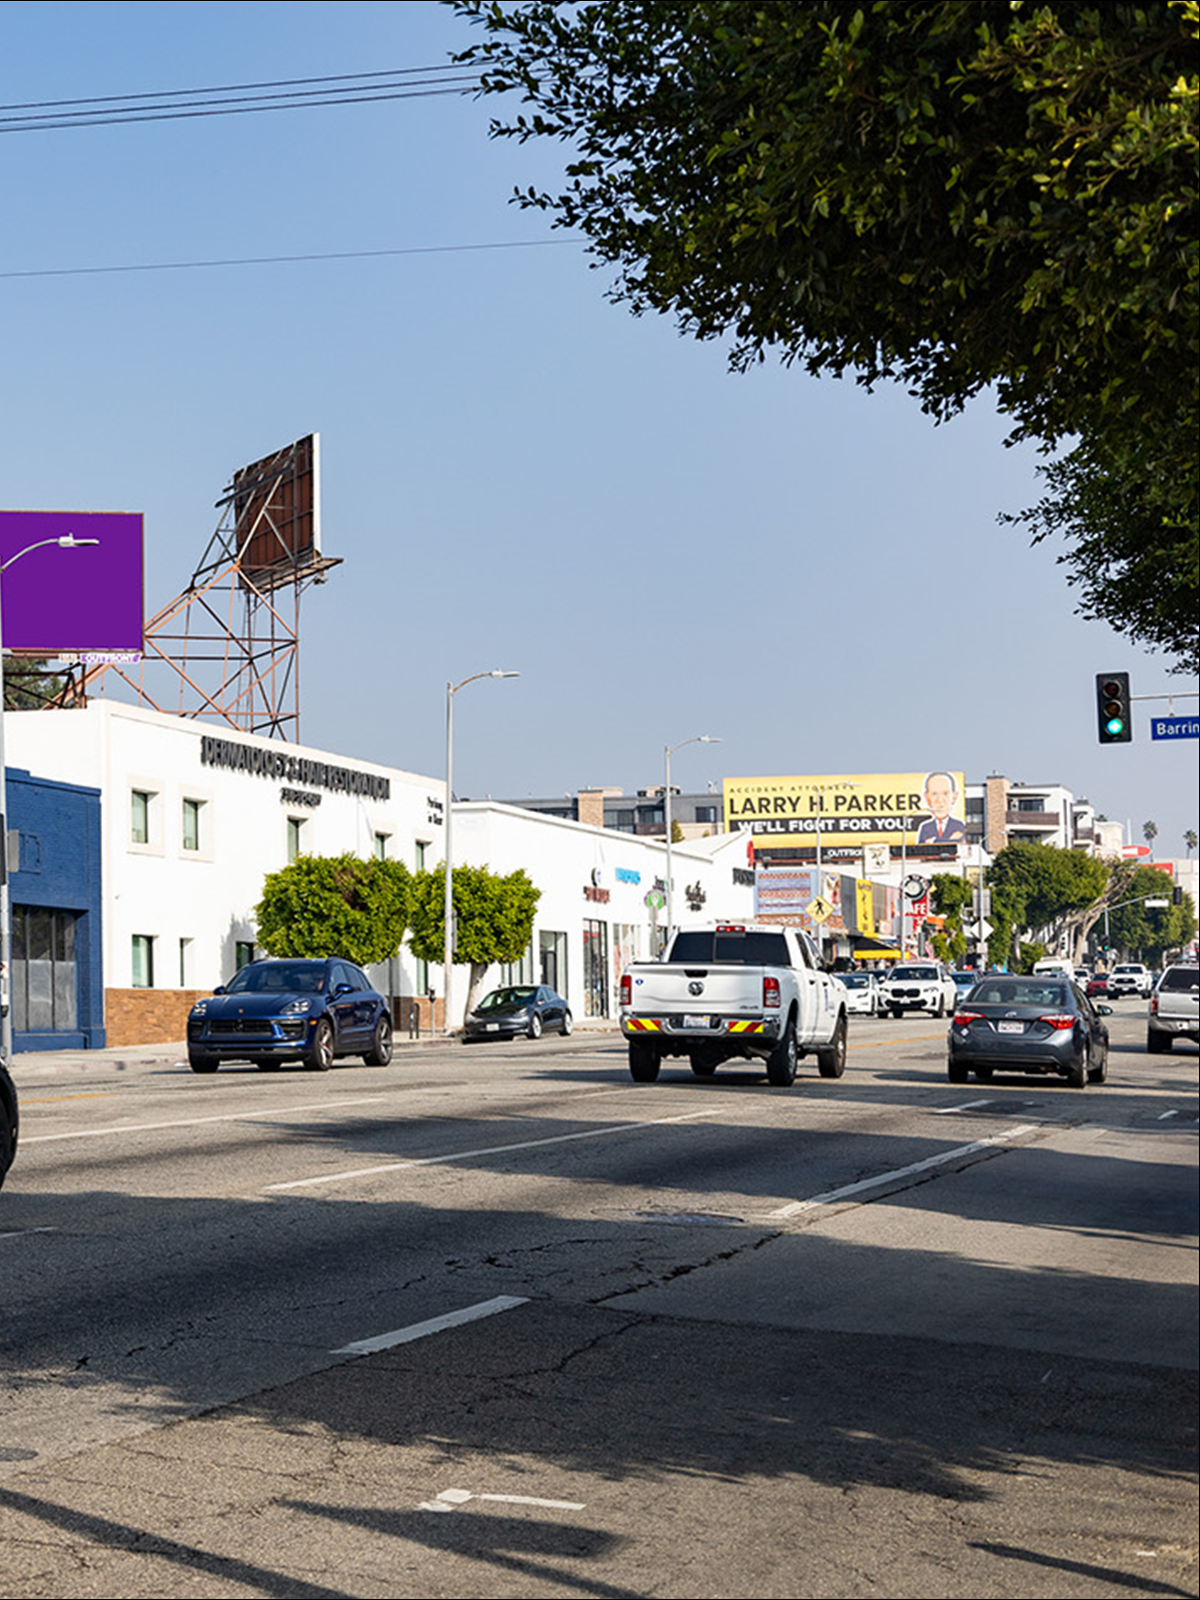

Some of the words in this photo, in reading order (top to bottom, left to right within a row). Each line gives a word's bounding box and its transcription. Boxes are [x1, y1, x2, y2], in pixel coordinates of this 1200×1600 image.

[84, 652, 136, 663] OUTFRONT
[1156, 721, 1199, 735] Barrin
[201, 736, 287, 779] DERMATOLOGY
[299, 757, 326, 786] HAIR
[326, 764, 391, 801] RESTORATION
[790, 784, 854, 792] ATTORNEYS
[730, 796, 801, 815] LARRY
[809, 795, 828, 812] H.
[834, 793, 922, 812] PARKER
[737, 820, 785, 834] WE'LL
[788, 819, 835, 832] FIGHT
[839, 818, 872, 831] FOR
[828, 848, 862, 857] OUTFRO
